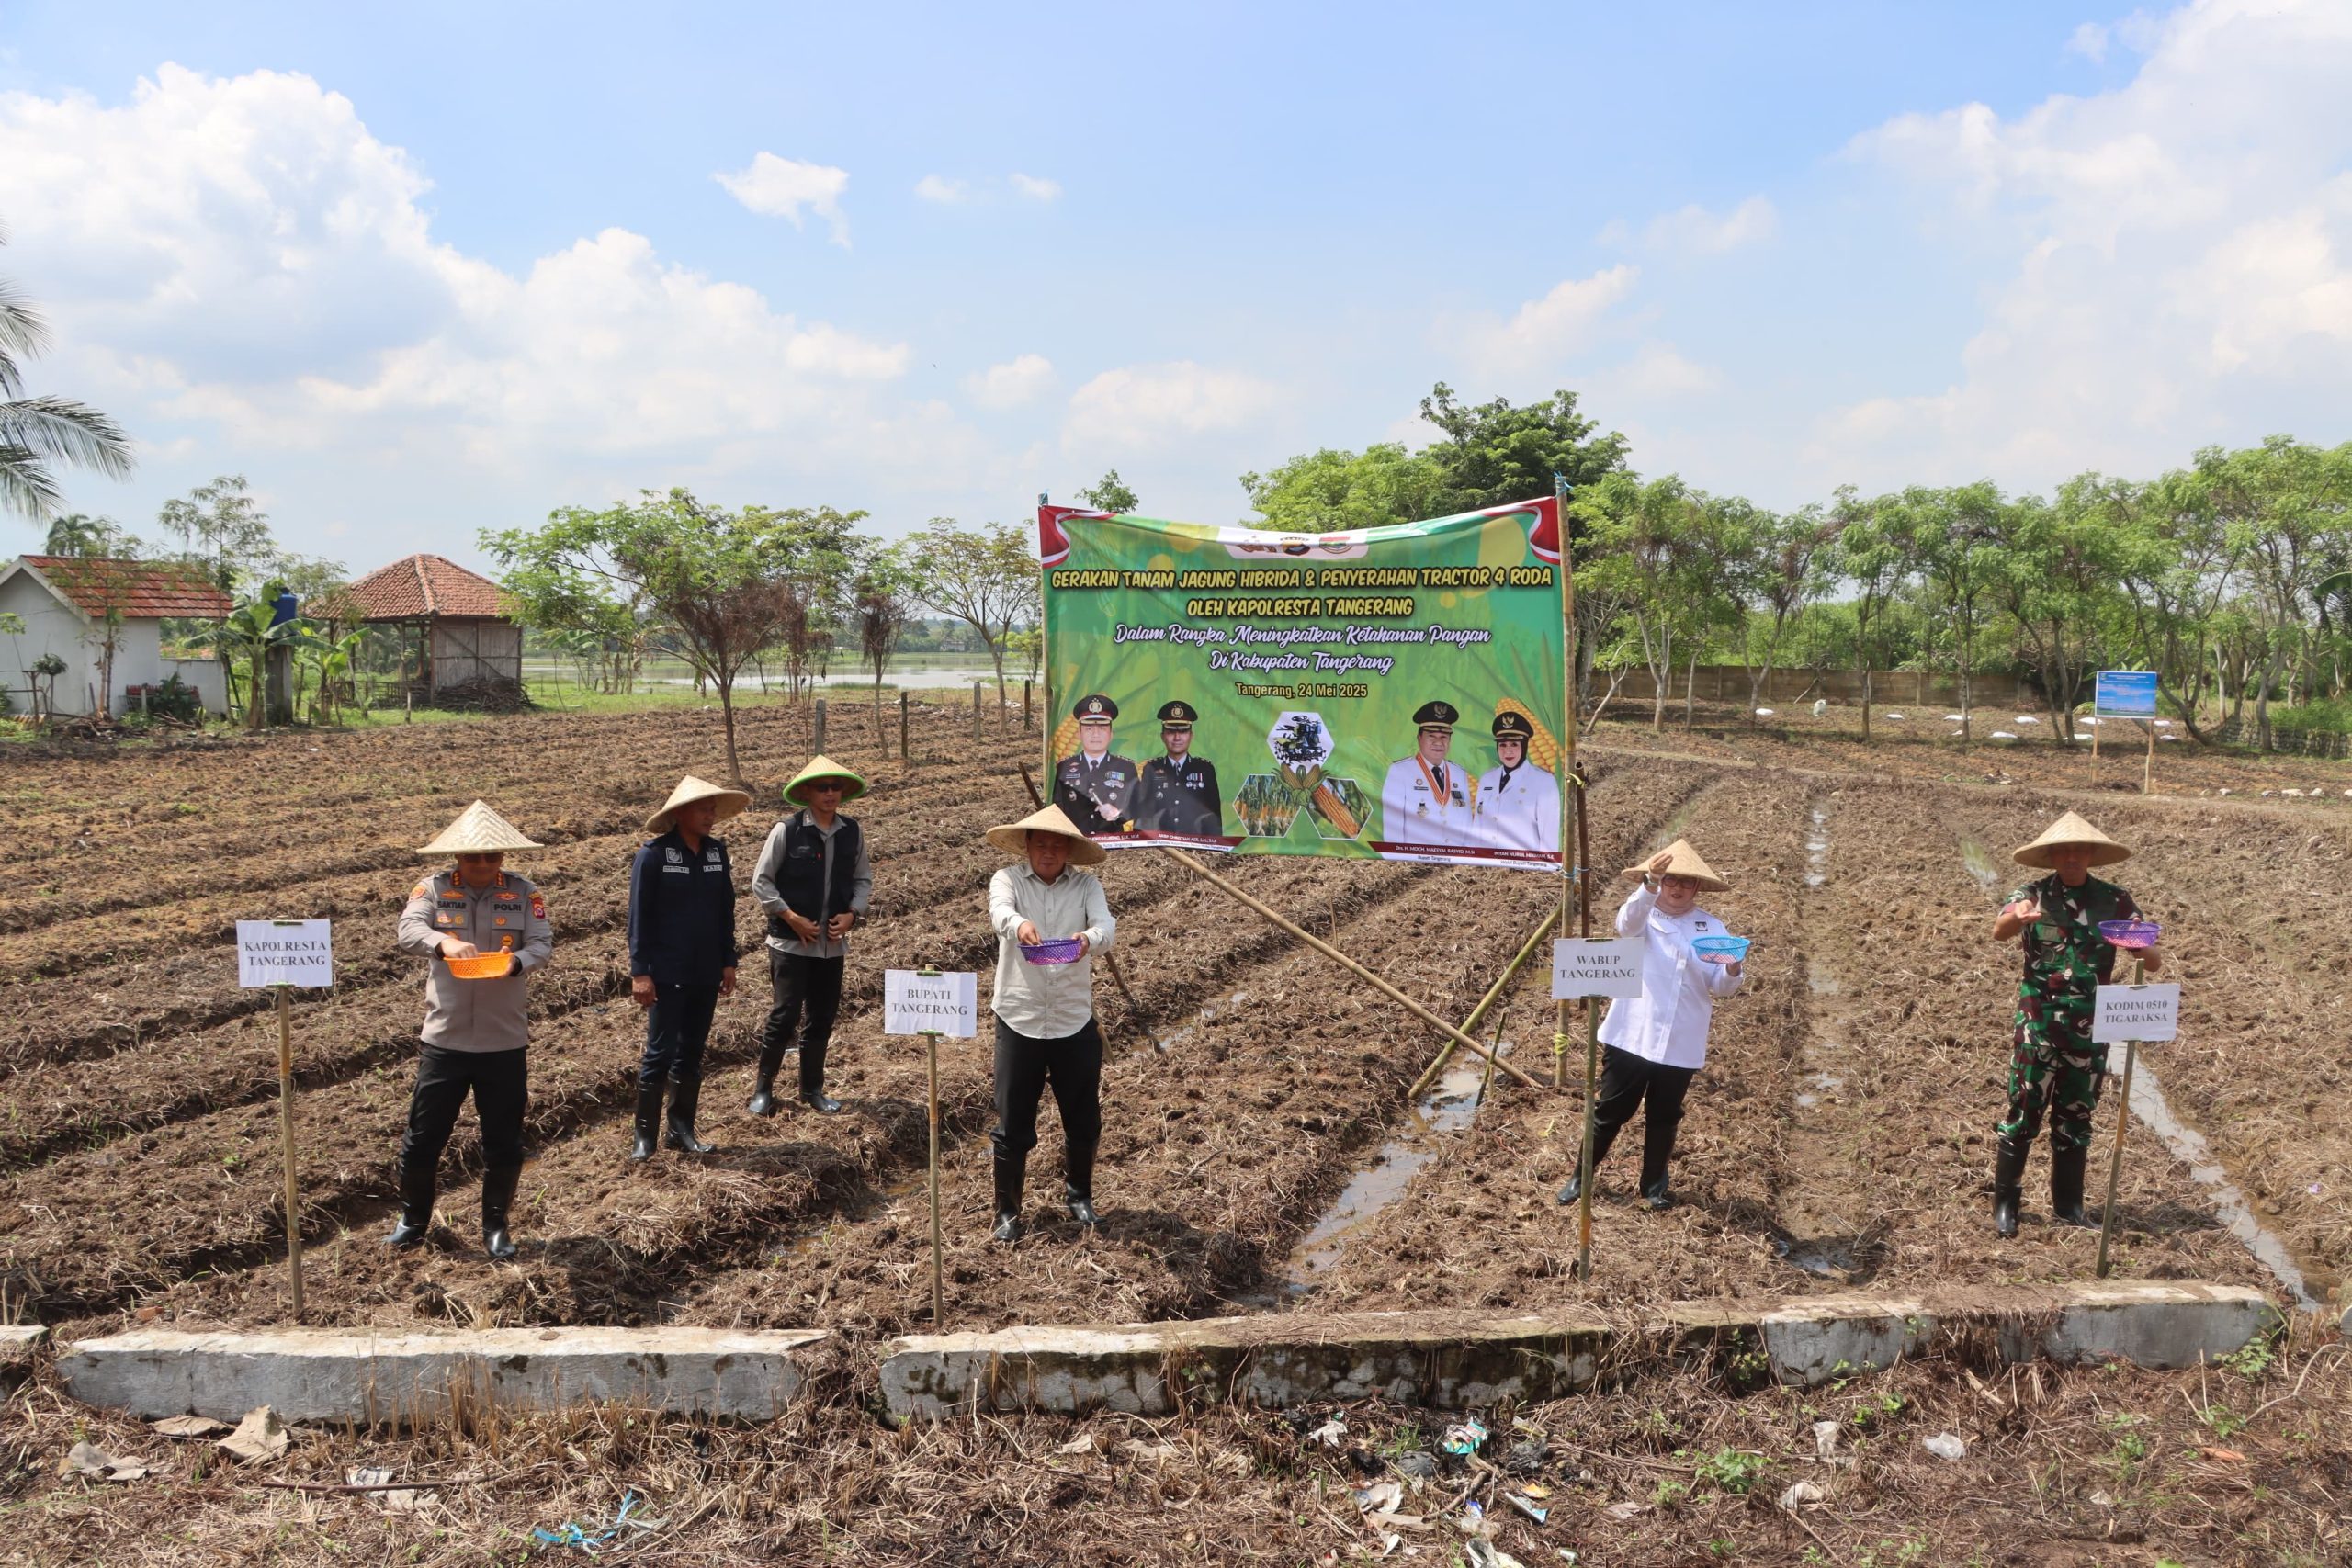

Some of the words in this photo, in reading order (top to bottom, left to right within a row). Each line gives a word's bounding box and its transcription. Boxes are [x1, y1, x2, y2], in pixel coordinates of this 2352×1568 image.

[1052, 570, 1119, 588] GERAKAN
[1122, 570, 1175, 588] TANAM
[1178, 570, 1236, 588] JAGUNG
[1240, 570, 1300, 587] HIBRIDA
[1304, 569, 1317, 587] &
[1320, 568, 1418, 587] PENYERAHAN
[1421, 567, 1490, 586] TRACTOR
[1493, 567, 1505, 585] 4
[1510, 566, 1552, 585] RODA
[1187, 599, 1223, 616] OLEH
[1227, 598, 1321, 616] KAPOLRESTA
[1326, 597, 1413, 615] TANGERANG
[1114, 624, 1166, 644] Dalam
[1168, 624, 1227, 648] Rangka
[1228, 625, 1343, 649] Meningkatkan
[1345, 625, 1428, 646] Ketahanan
[1428, 624, 1492, 649] Pangan
[1209, 650, 1229, 671] Di
[1230, 651, 1310, 674] Kabupaten
[1311, 651, 1395, 676] Tangerang
[1236, 682, 1296, 699] Tangerang,
[1297, 683, 1312, 697] 24
[1316, 683, 1337, 697] Mei
[1339, 683, 1368, 698] 2025
[494, 903, 522, 911] POLRI
[244, 941, 326, 952] KAPOLRESTA
[249, 955, 325, 966] TANGERANG
[1577, 955, 1621, 965] WABUP
[1560, 969, 1635, 979] TANGERANG
[907, 988, 951, 1000] BUPATI
[892, 1002, 968, 1016] TANGERANG
[2106, 1001, 2144, 1010] KODIM
[2146, 1000, 2168, 1010] 0510
[2105, 1013, 2168, 1023] TIGARAKSA
